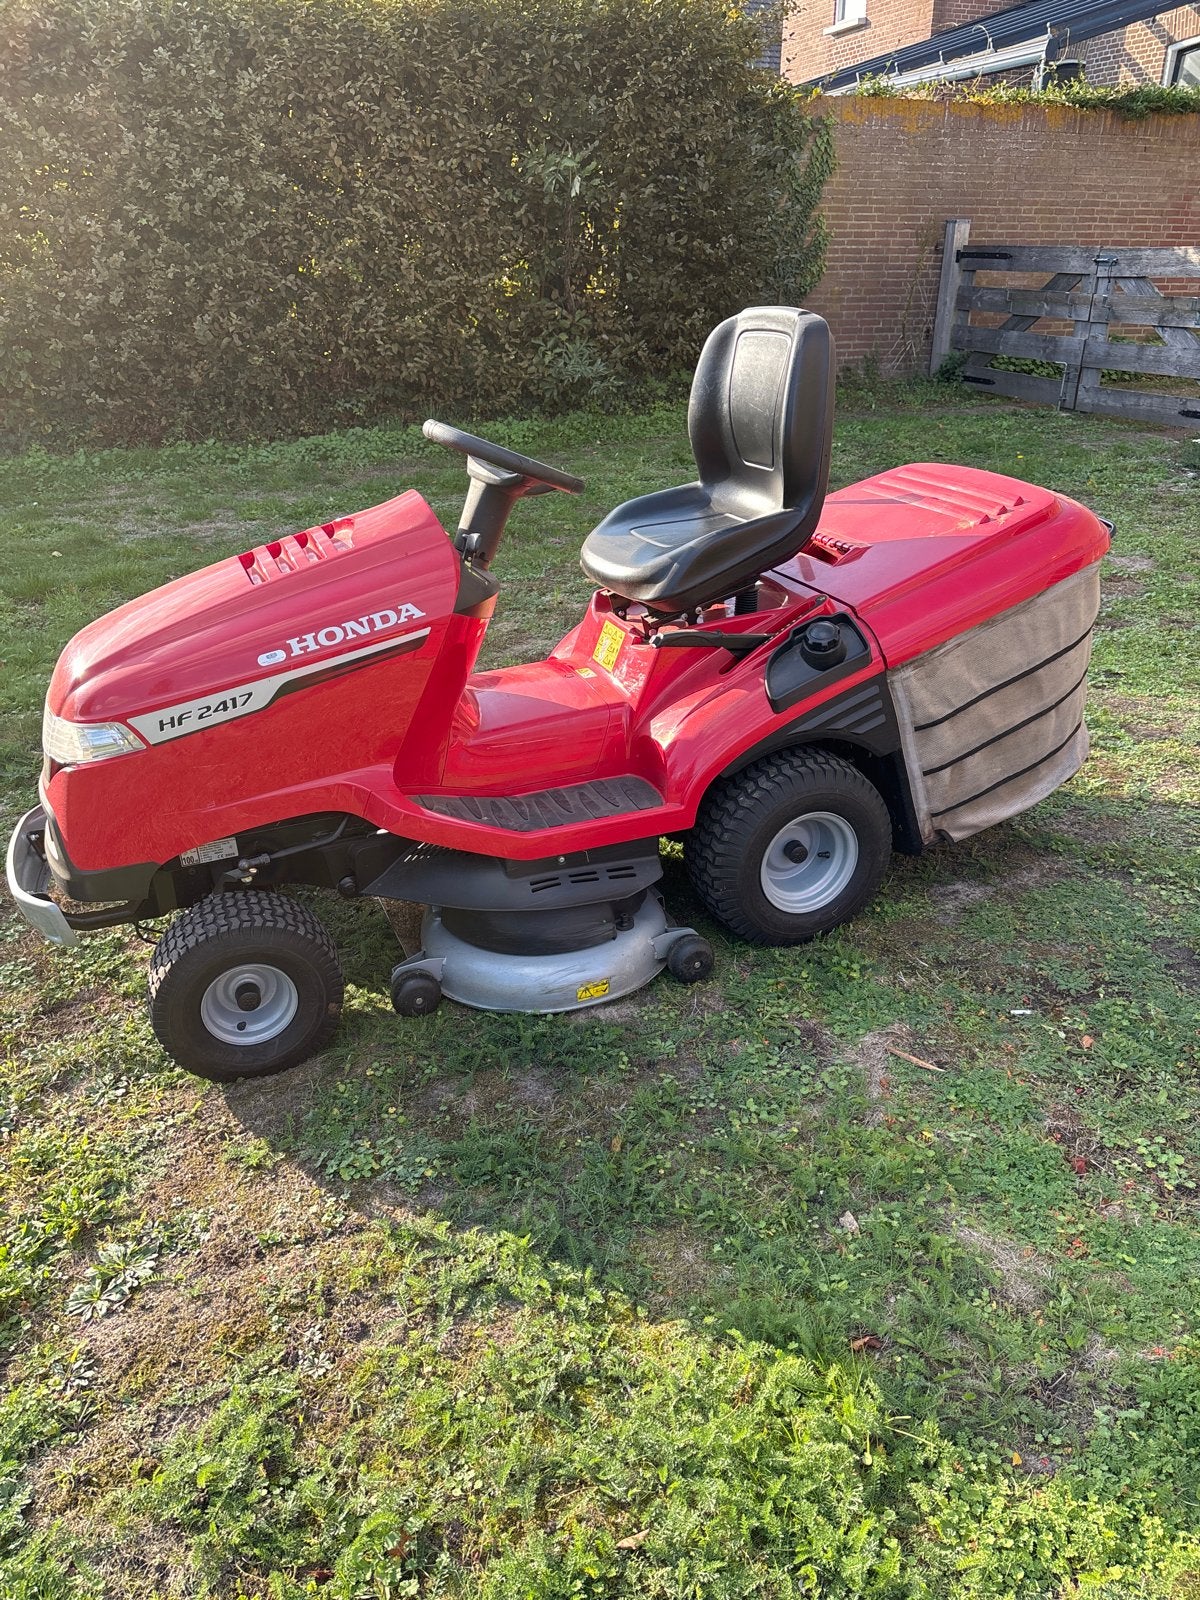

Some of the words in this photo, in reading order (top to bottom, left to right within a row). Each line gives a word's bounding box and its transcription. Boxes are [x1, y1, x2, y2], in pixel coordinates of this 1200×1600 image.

[286, 603, 426, 656] HONDA
[159, 711, 192, 731] HF
[198, 692, 253, 720] 2417
[182, 856, 195, 865] 100
